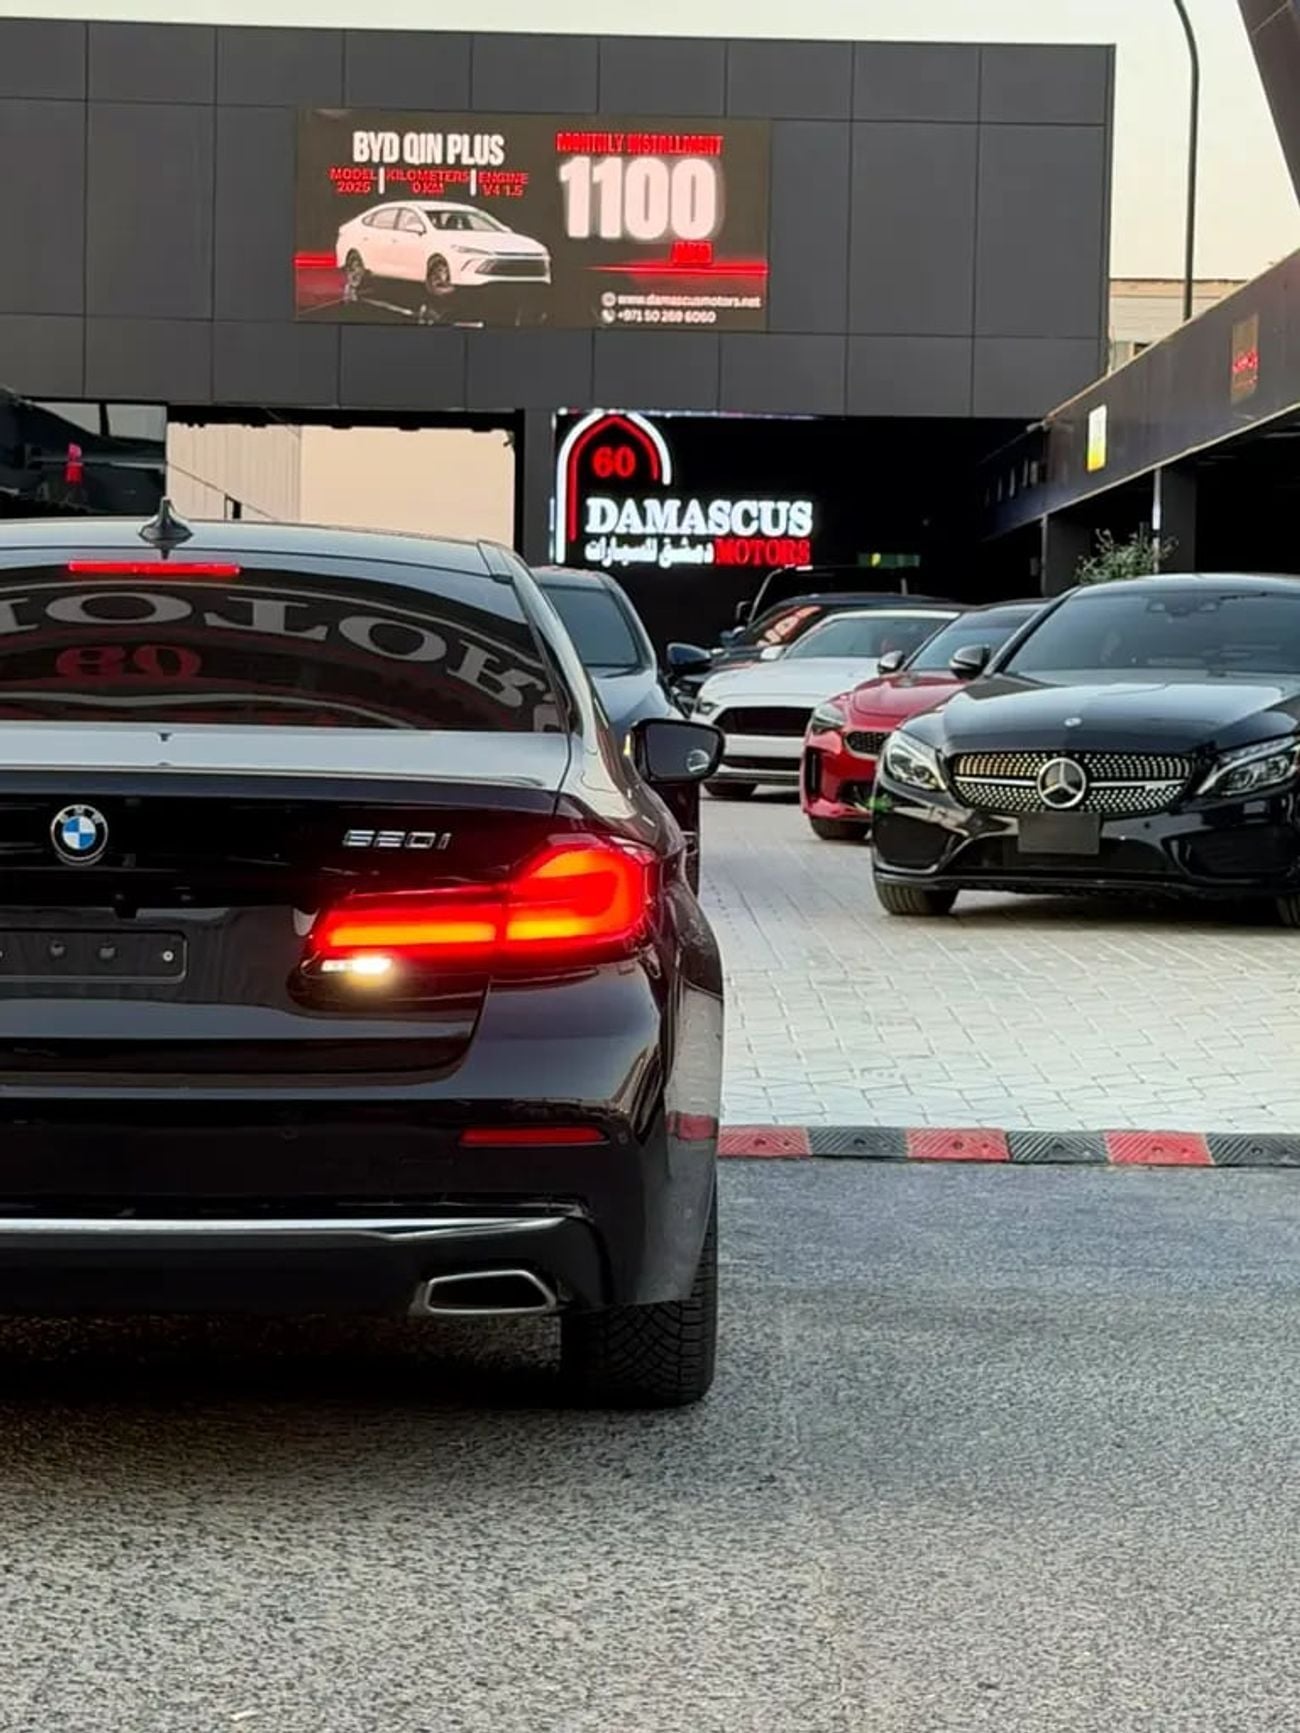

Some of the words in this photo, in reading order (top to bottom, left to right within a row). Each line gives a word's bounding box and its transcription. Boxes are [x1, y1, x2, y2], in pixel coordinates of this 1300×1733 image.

[352, 131, 400, 163] BYD
[403, 132, 443, 166] QIN
[446, 134, 506, 166] PLUS
[556, 132, 625, 153] MONTHLY
[627, 133, 723, 156] INSTALLMENT
[329, 167, 378, 181] MODEL
[337, 181, 372, 194] 2025
[386, 168, 470, 183] KILOMETERS
[477, 171, 529, 185] ENGINE
[558, 155, 718, 240] 1100
[591, 446, 636, 478] 60
[584, 497, 814, 537] DAMASCUS
[659, 537, 714, 568] دمشق
[714, 538, 811, 568] MOTORS
